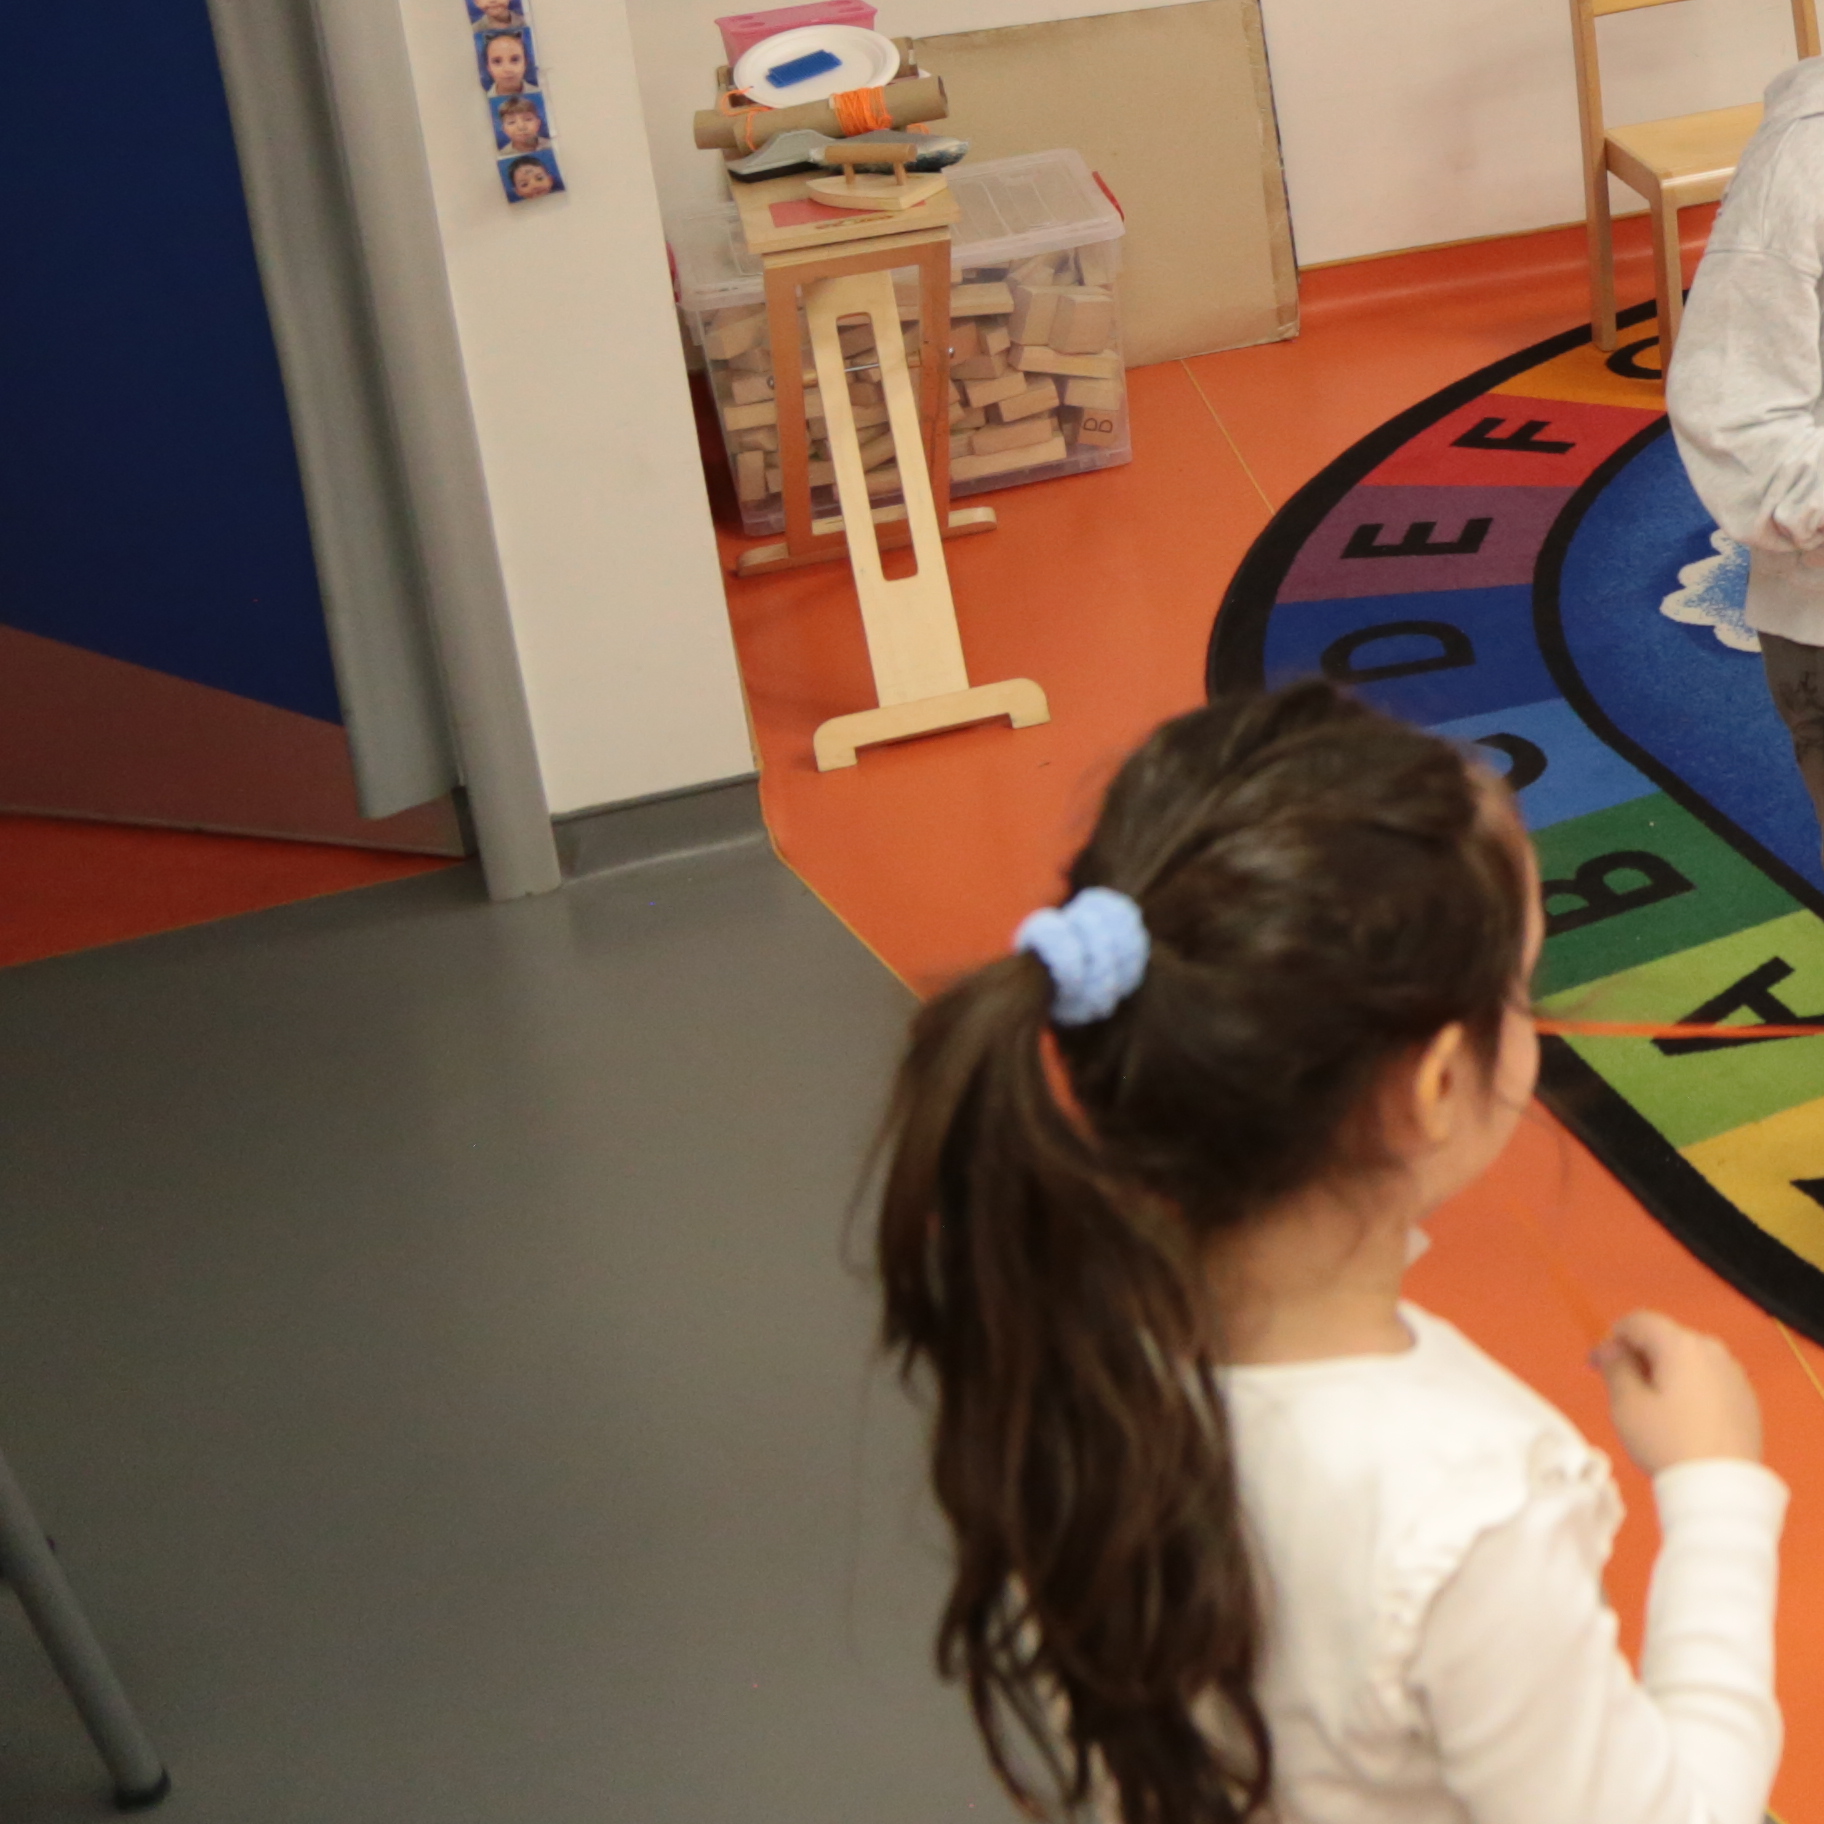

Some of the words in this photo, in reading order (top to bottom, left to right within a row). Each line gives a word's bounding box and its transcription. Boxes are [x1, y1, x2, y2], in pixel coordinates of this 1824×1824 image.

[1451, 416, 1578, 453] F
[1340, 517, 1492, 560] E
[1320, 620, 1476, 682] D
[1537, 849, 1695, 937] B
